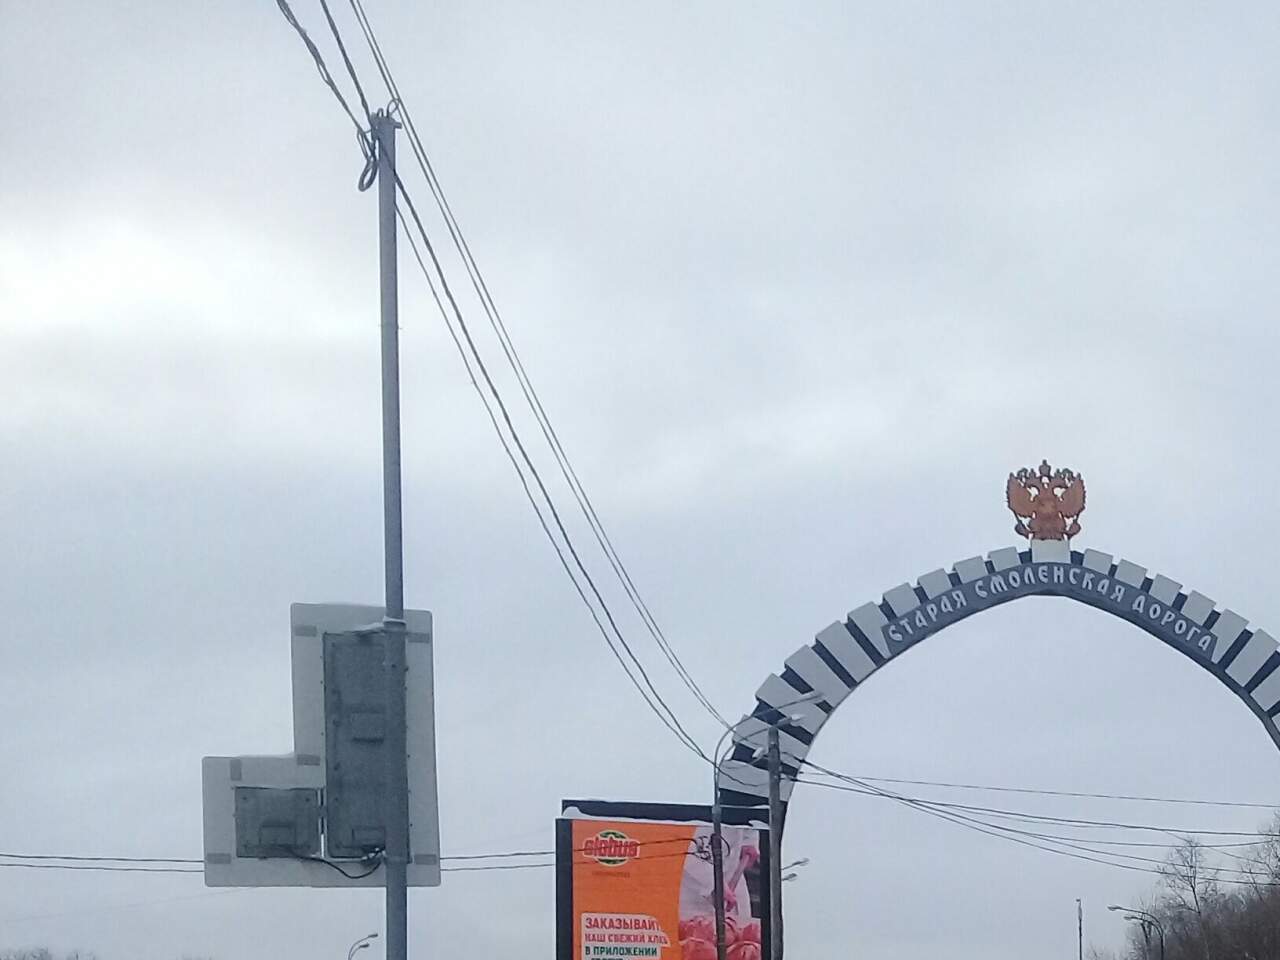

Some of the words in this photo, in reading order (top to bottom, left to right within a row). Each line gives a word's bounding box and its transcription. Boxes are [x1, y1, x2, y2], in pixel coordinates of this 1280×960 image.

[888, 590, 967, 641] СТАРАЯ
[974, 565, 1126, 603] СМОЛЕНСКАЯ
[1132, 596, 1212, 650] ДОРОГА
[585, 945, 591, 955] В
[593, 946, 657, 956] ПРИЛОЖЕНИИ
